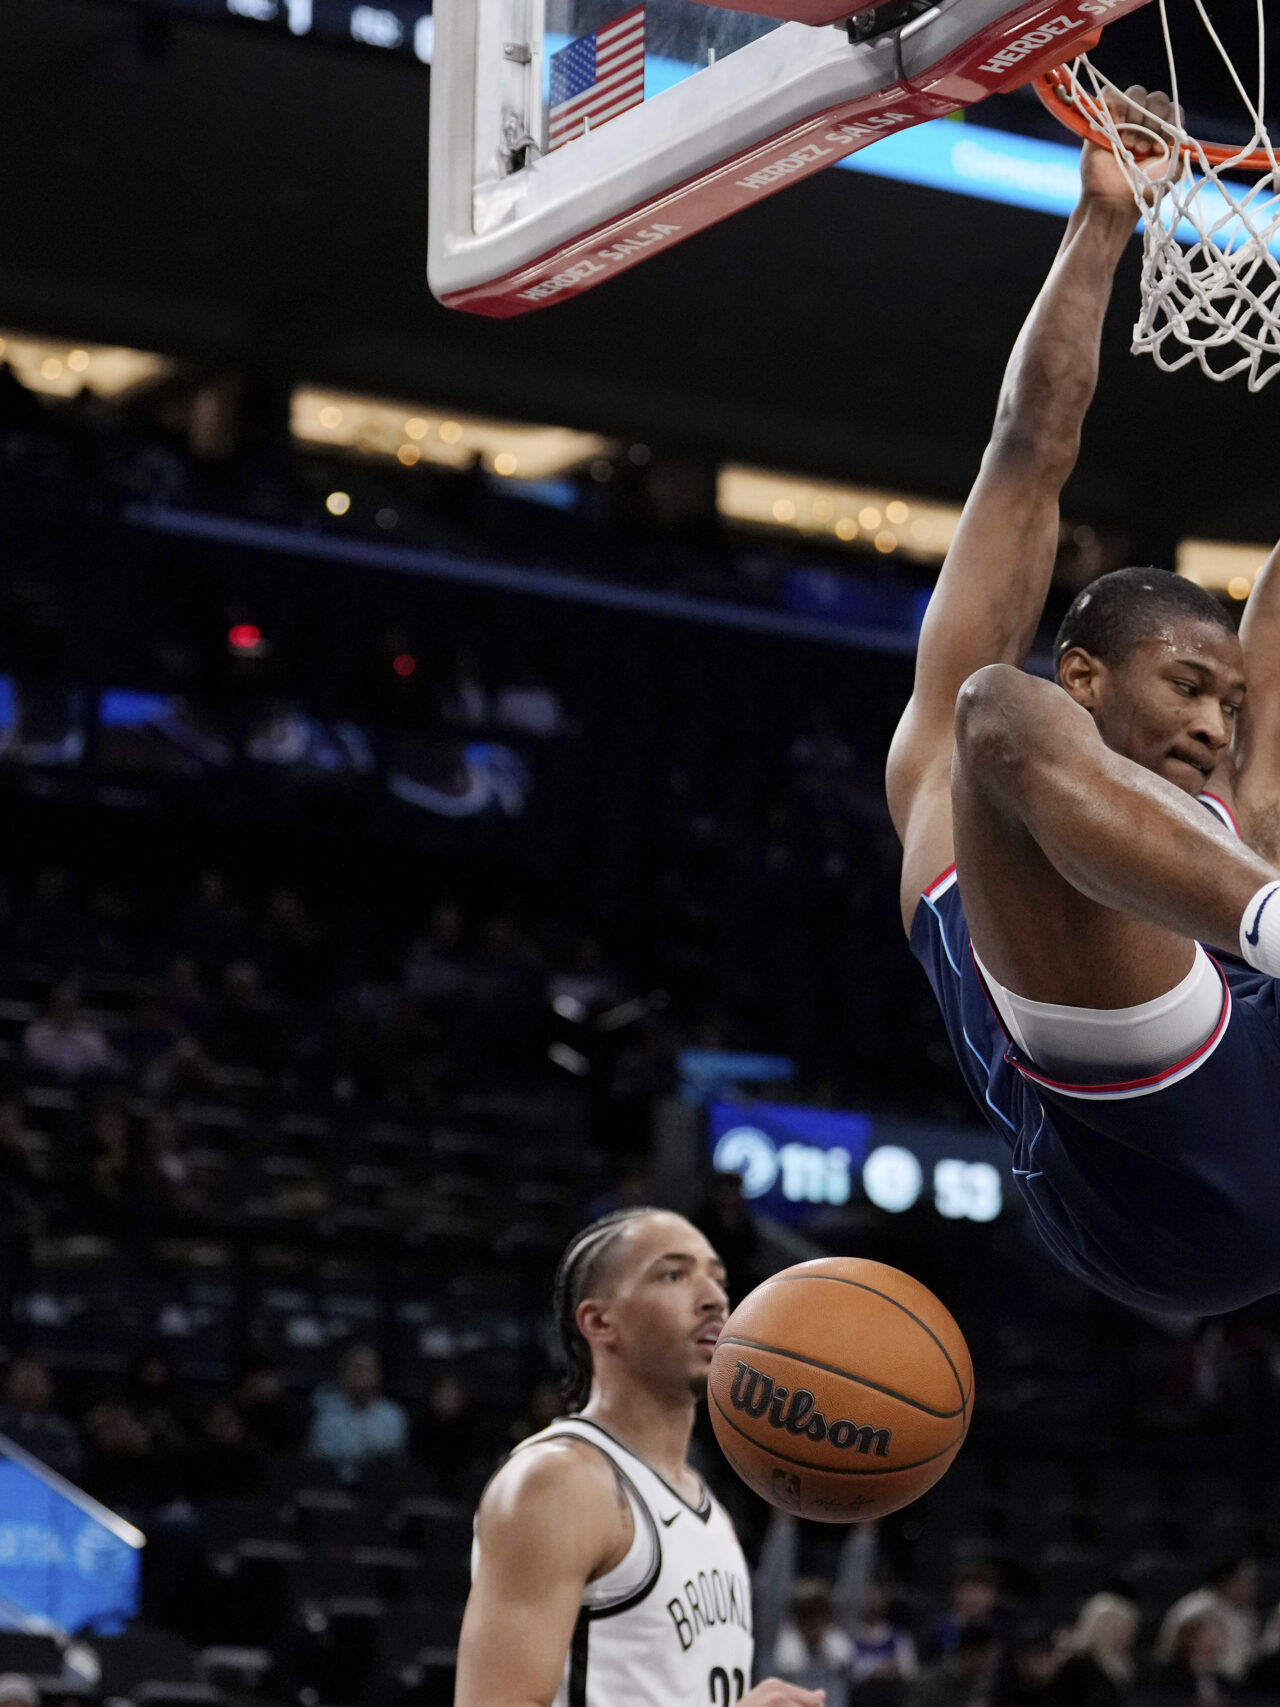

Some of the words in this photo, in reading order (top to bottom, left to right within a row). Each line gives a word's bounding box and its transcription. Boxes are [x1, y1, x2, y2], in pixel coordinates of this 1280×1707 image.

[977, 15, 1086, 74] HERDEZ
[735, 143, 832, 189] HERDEZ
[825, 111, 915, 144] SALSA
[516, 259, 606, 301] HERDEZ
[598, 223, 681, 261] SALSA
[730, 1359, 892, 1458] Wilson
